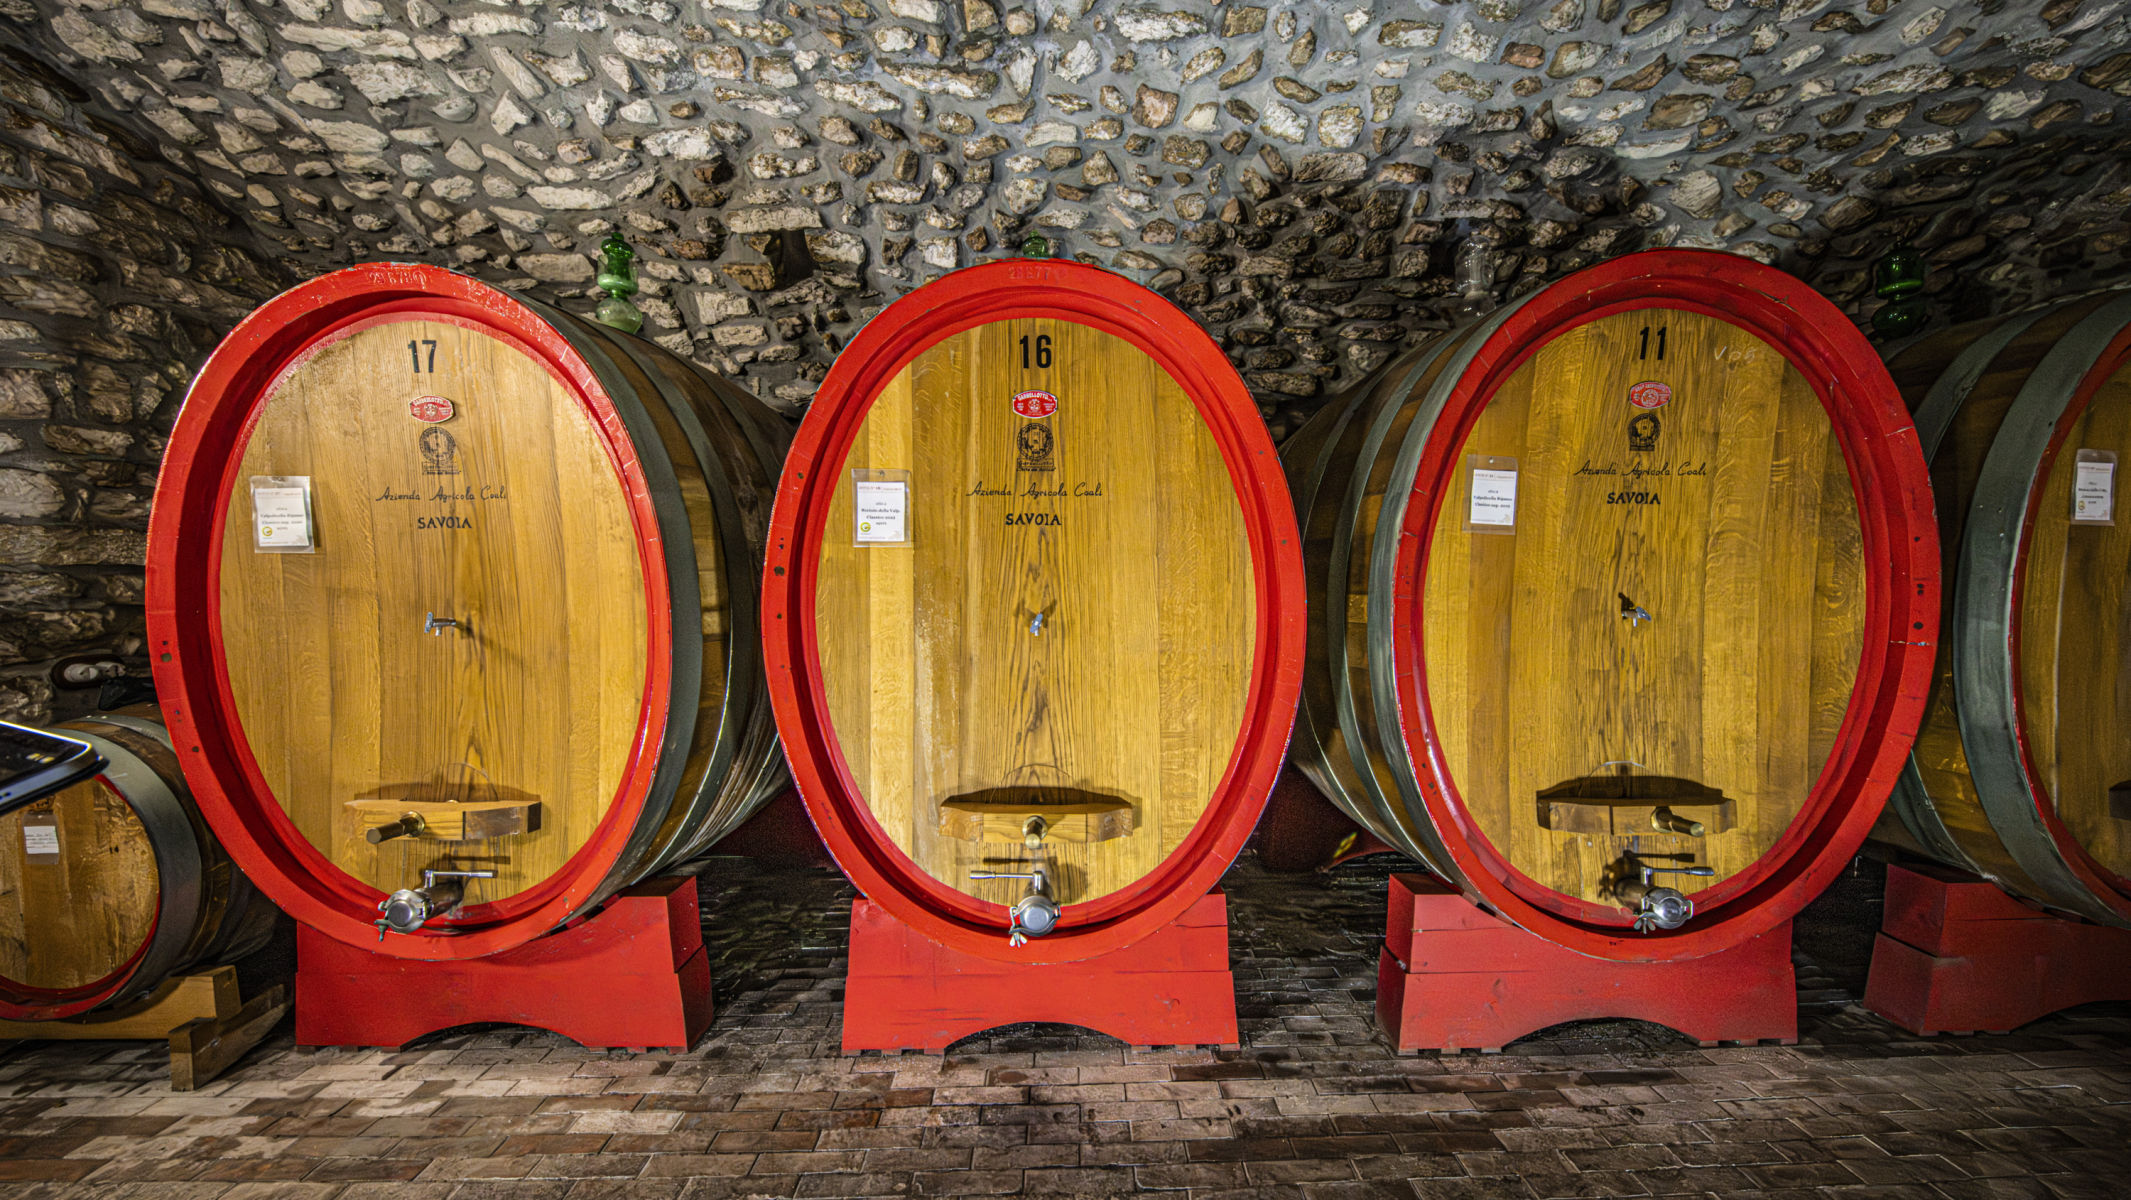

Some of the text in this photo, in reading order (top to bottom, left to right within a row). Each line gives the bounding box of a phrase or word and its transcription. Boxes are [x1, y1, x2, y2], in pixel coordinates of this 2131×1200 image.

[1640, 326, 1667, 360] 11
[407, 339, 437, 373] 17
[1019, 335, 1052, 369] 16
[1621, 462, 1672, 479] Agricola
[376, 486, 421, 502] Azienda
[428, 486, 476, 503] Agricola
[966, 481, 1103, 498] Azienda Agricola Coali
[1607, 492, 1661, 505] SAVOIA
[417, 516, 472, 529] SAVOIA
[1005, 513, 1062, 526] SAVOIA
